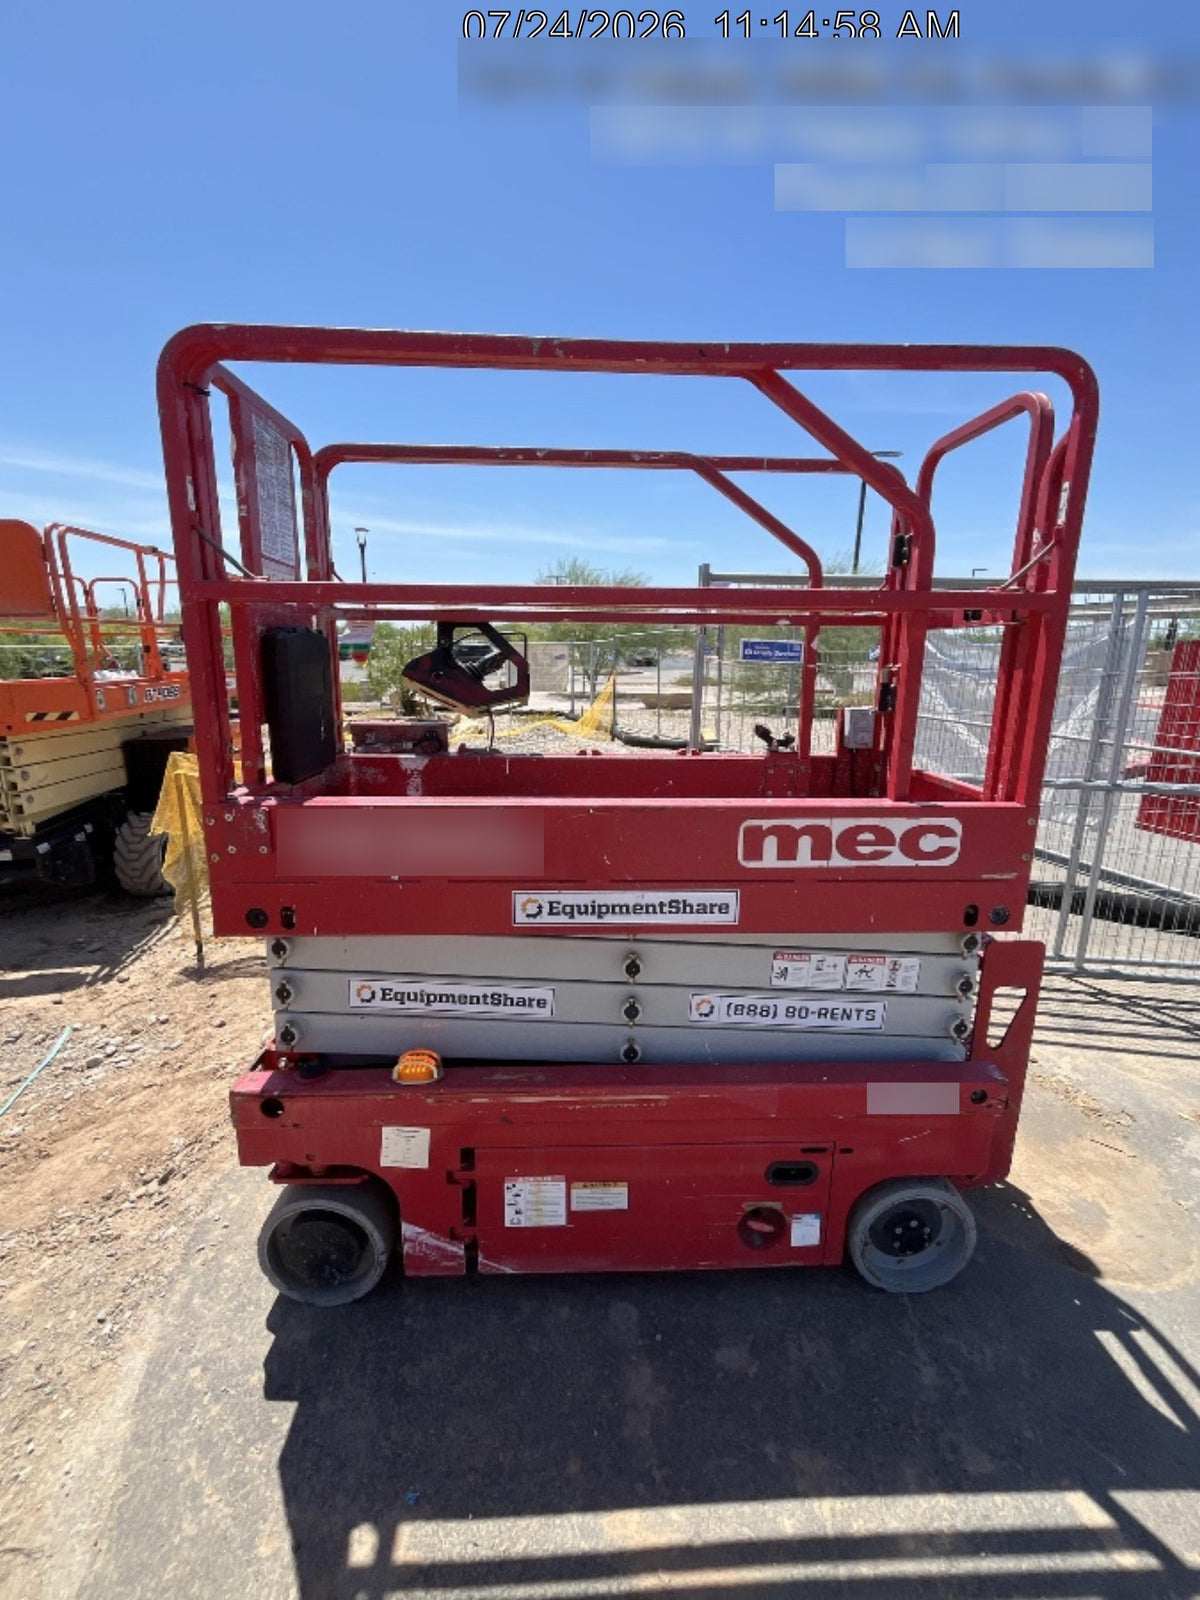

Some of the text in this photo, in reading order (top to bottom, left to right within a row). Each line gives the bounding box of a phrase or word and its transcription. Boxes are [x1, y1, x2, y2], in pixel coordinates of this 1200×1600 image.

[742, 823, 958, 862] mec
[547, 897, 730, 920] EquipmentShare
[379, 987, 548, 1009] EquipmentShare
[726, 1002, 877, 1022] (888) 80-RENTS
